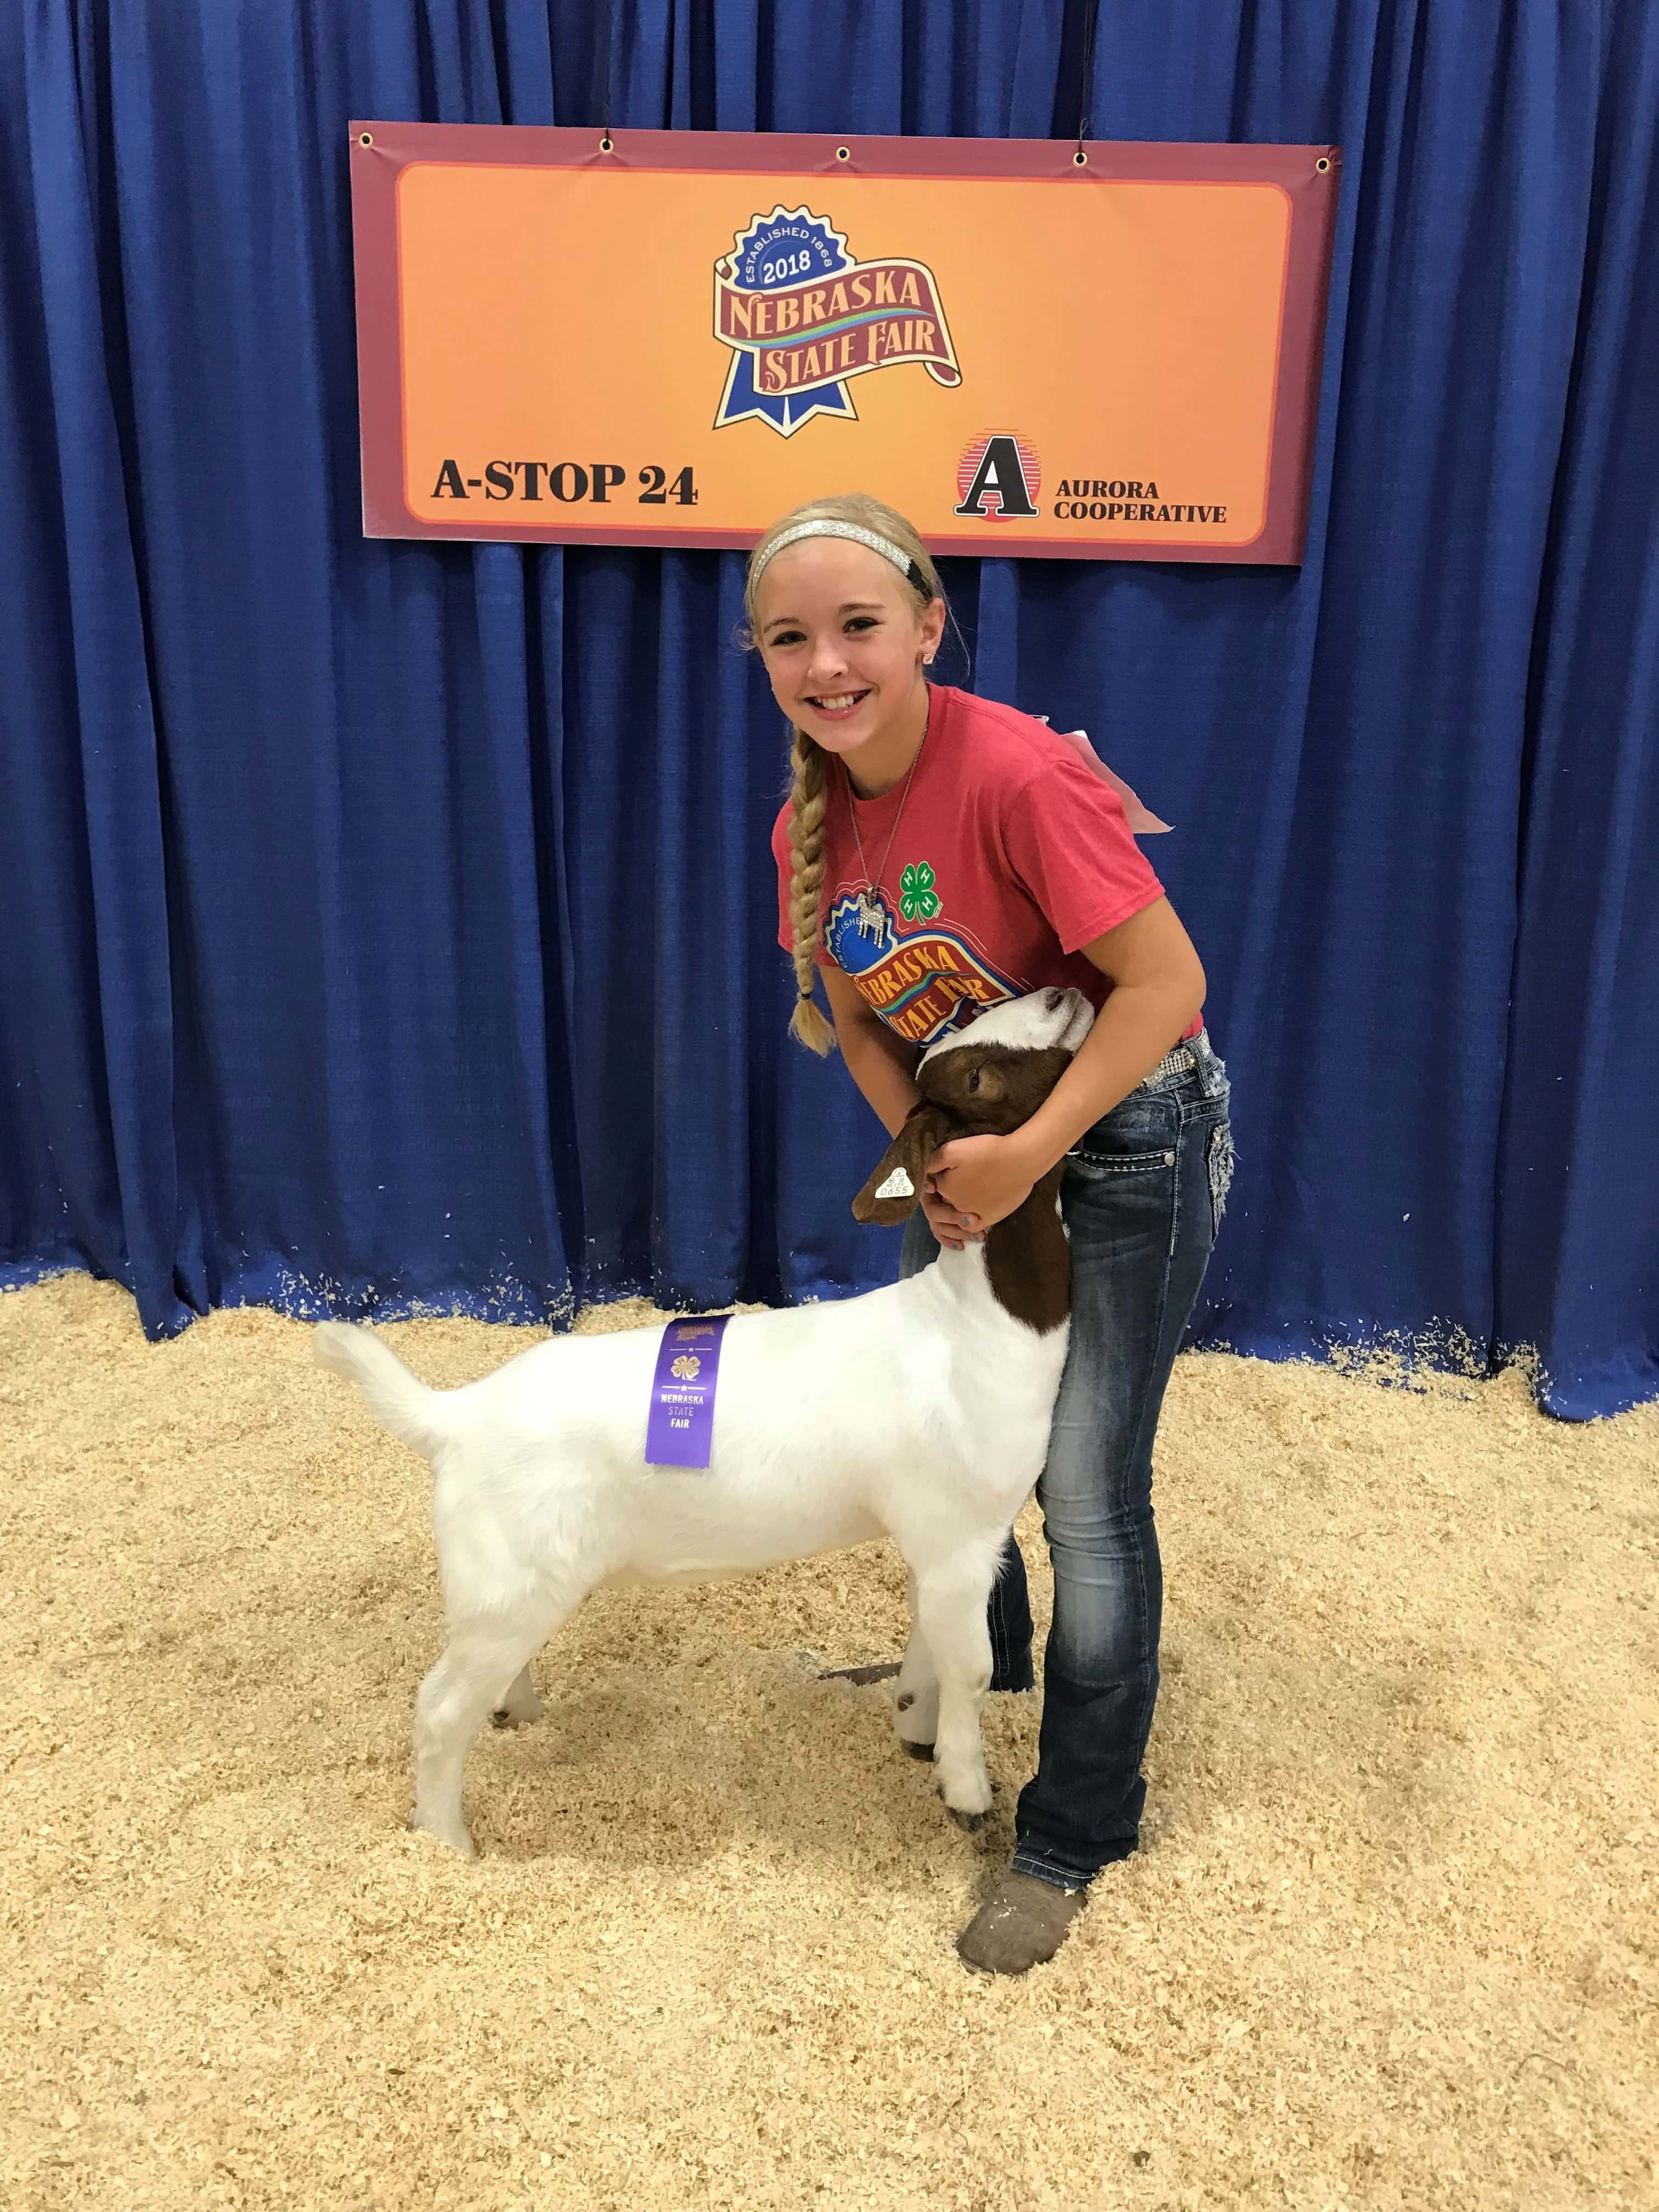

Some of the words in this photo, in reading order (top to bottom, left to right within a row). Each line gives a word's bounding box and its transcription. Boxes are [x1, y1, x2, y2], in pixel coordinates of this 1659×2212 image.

[746, 227, 809, 283] ESTABLISHED
[811, 237, 832, 268] 1868
[763, 250, 811, 284] 2018
[730, 270, 921, 338] NEBRASKA
[761, 333, 856, 393] STATE
[867, 320, 936, 365] FAIR
[430, 459, 626, 503] A-STOP
[639, 465, 698, 506] 24
[954, 436, 1040, 517] A
[1056, 479, 1160, 499] AURORA
[1054, 501, 1227, 523] COOPERATIVE
[835, 917, 861, 968] ESTABLISHE
[881, 1186, 909, 1196] 0655
[661, 1394, 704, 1405] NEBRASKA
[668, 1406, 694, 1416] STATE
[671, 1418, 690, 1428] FAIR
